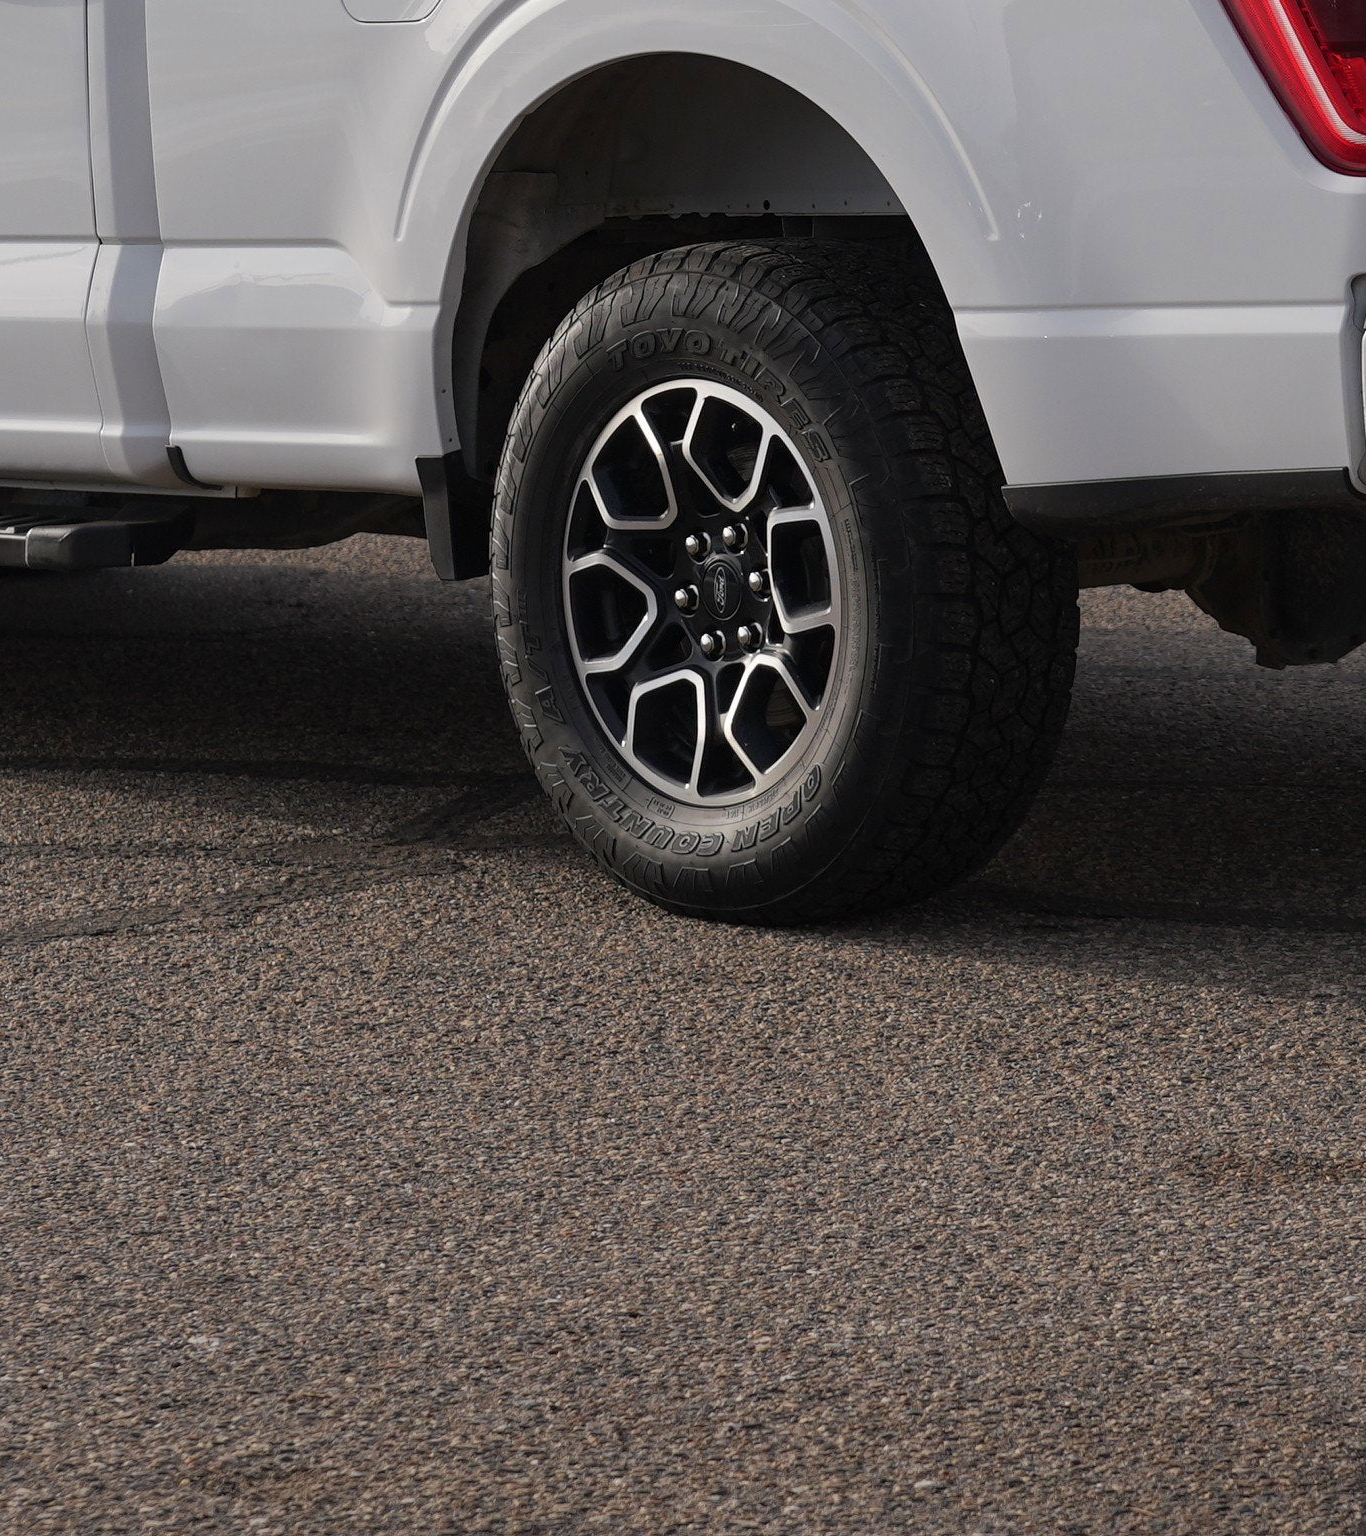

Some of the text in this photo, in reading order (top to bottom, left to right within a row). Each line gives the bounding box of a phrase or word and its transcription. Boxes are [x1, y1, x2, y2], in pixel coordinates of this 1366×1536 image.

[605, 327, 712, 373] TOYO
[715, 338, 831, 463] TIRES
[559, 745, 726, 858] COUNTRY
[731, 763, 822, 853] OPEN
